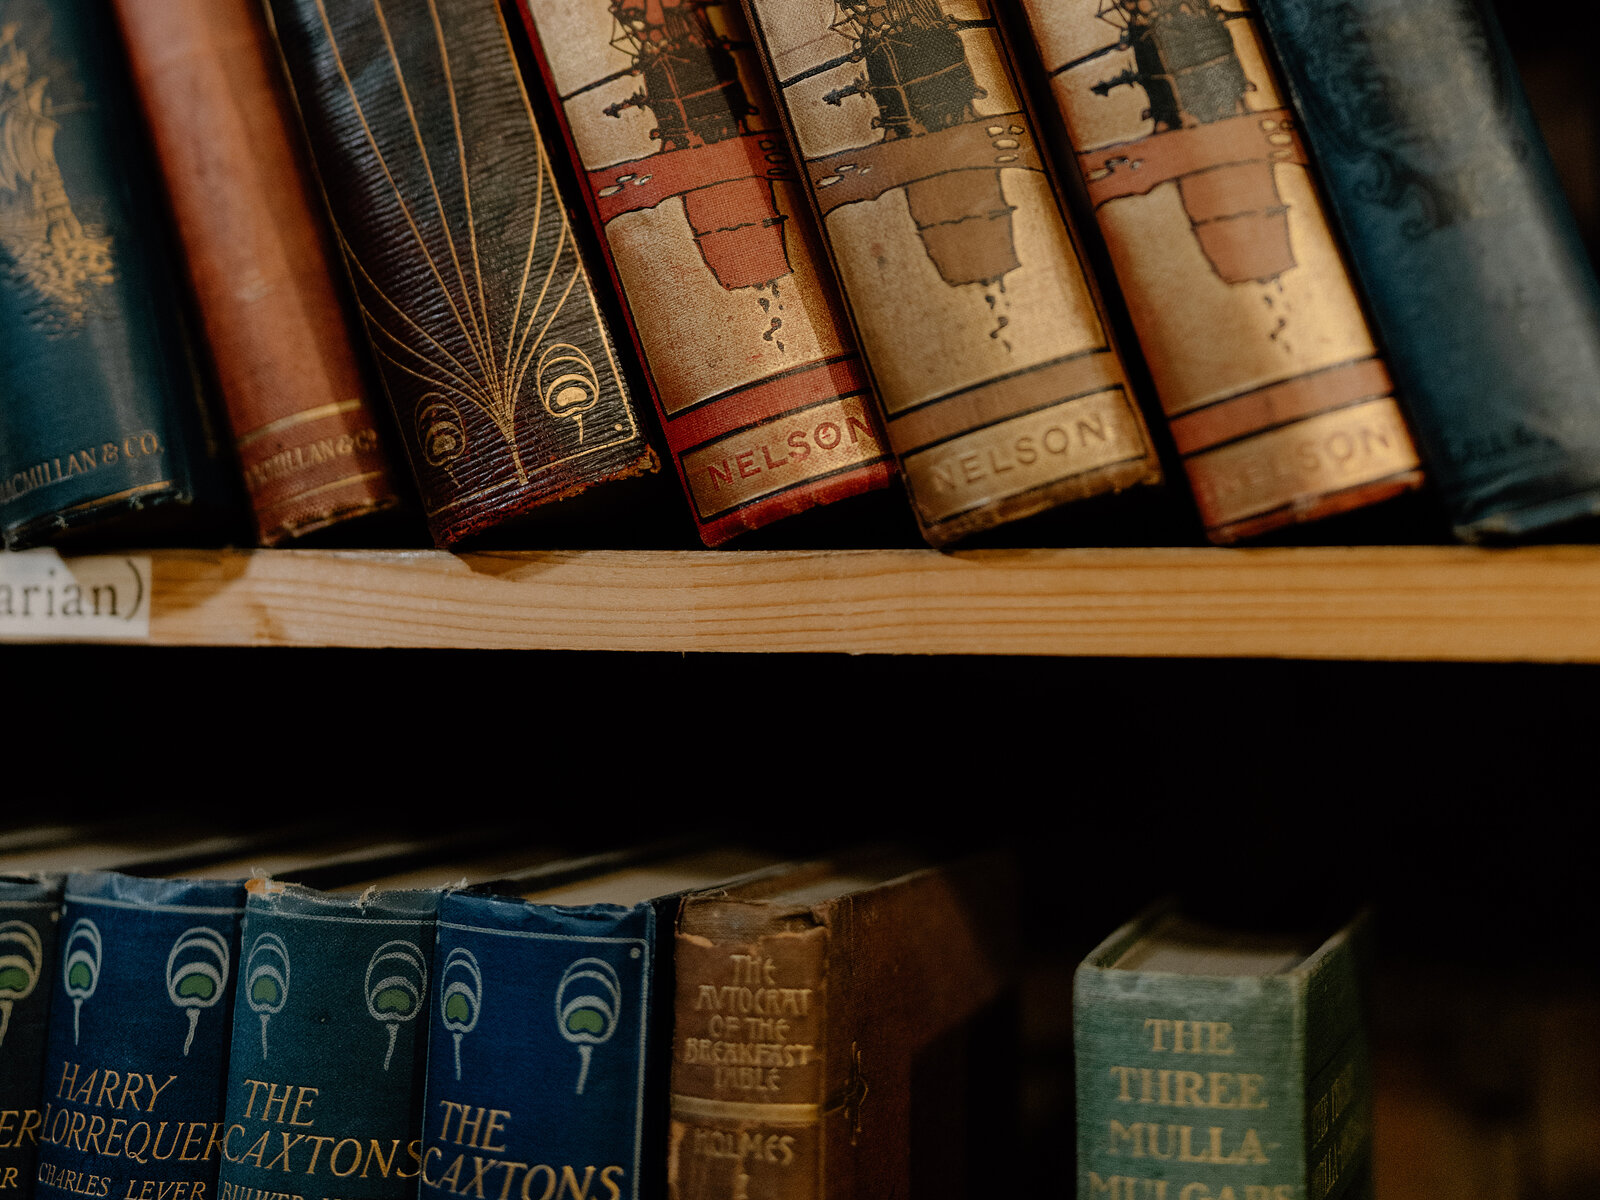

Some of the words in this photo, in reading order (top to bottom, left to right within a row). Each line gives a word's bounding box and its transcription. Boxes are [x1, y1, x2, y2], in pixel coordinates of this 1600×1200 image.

[102, 442, 119, 465] &
[707, 415, 875, 493] NELSON
[932, 414, 1108, 493] NELSON
[709, 1014, 741, 1038] OF
[1143, 1017, 1236, 1056] THE
[56, 1060, 178, 1112] HARRY
[243, 1078, 319, 1127] THE
[1109, 1065, 1269, 1110] THREE
[222, 1123, 423, 1178] CAXTONS
[439, 1100, 511, 1153] THE
[38, 1162, 111, 1197] CHARLES
[124, 1179, 207, 1200] LEVER
[421, 1146, 625, 1200] CAXTONS
